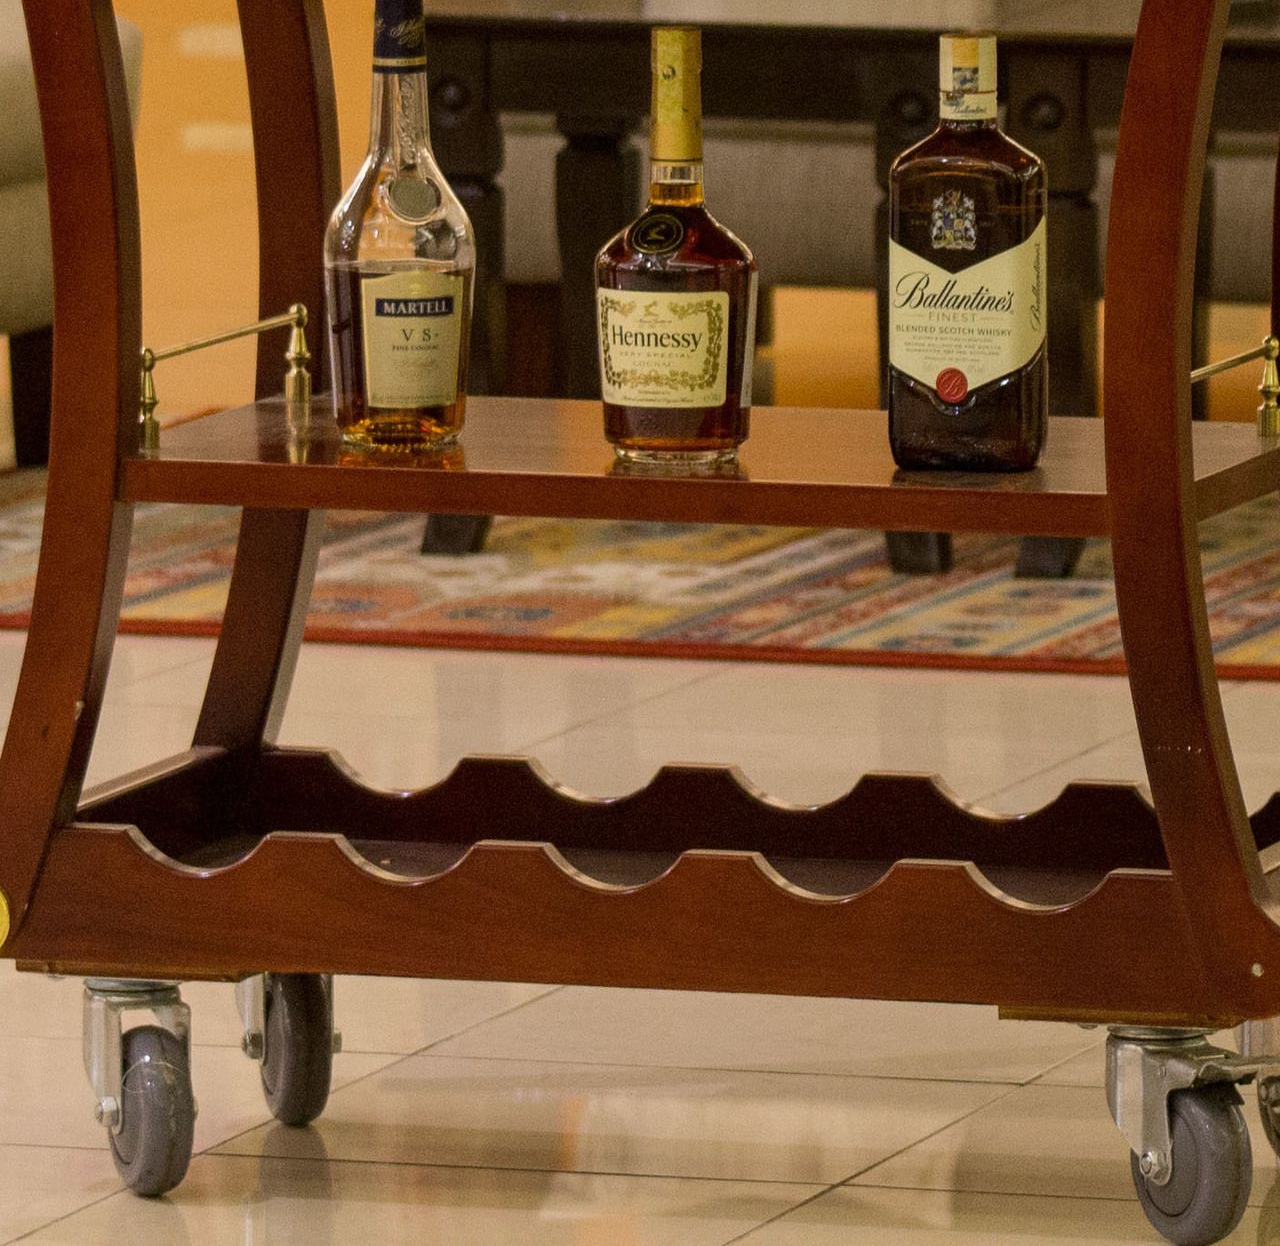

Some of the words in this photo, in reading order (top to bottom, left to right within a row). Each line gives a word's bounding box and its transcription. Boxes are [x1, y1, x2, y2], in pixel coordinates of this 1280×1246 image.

[893, 270, 1015, 313] Ballantine's
[383, 299, 449, 314] MARTELL
[928, 311, 978, 323] FINEST
[895, 324, 936, 333] BLENDED
[938, 326, 975, 336] SCOTCH
[977, 327, 1013, 337] WHISKY
[611, 324, 703, 353] Hennessy
